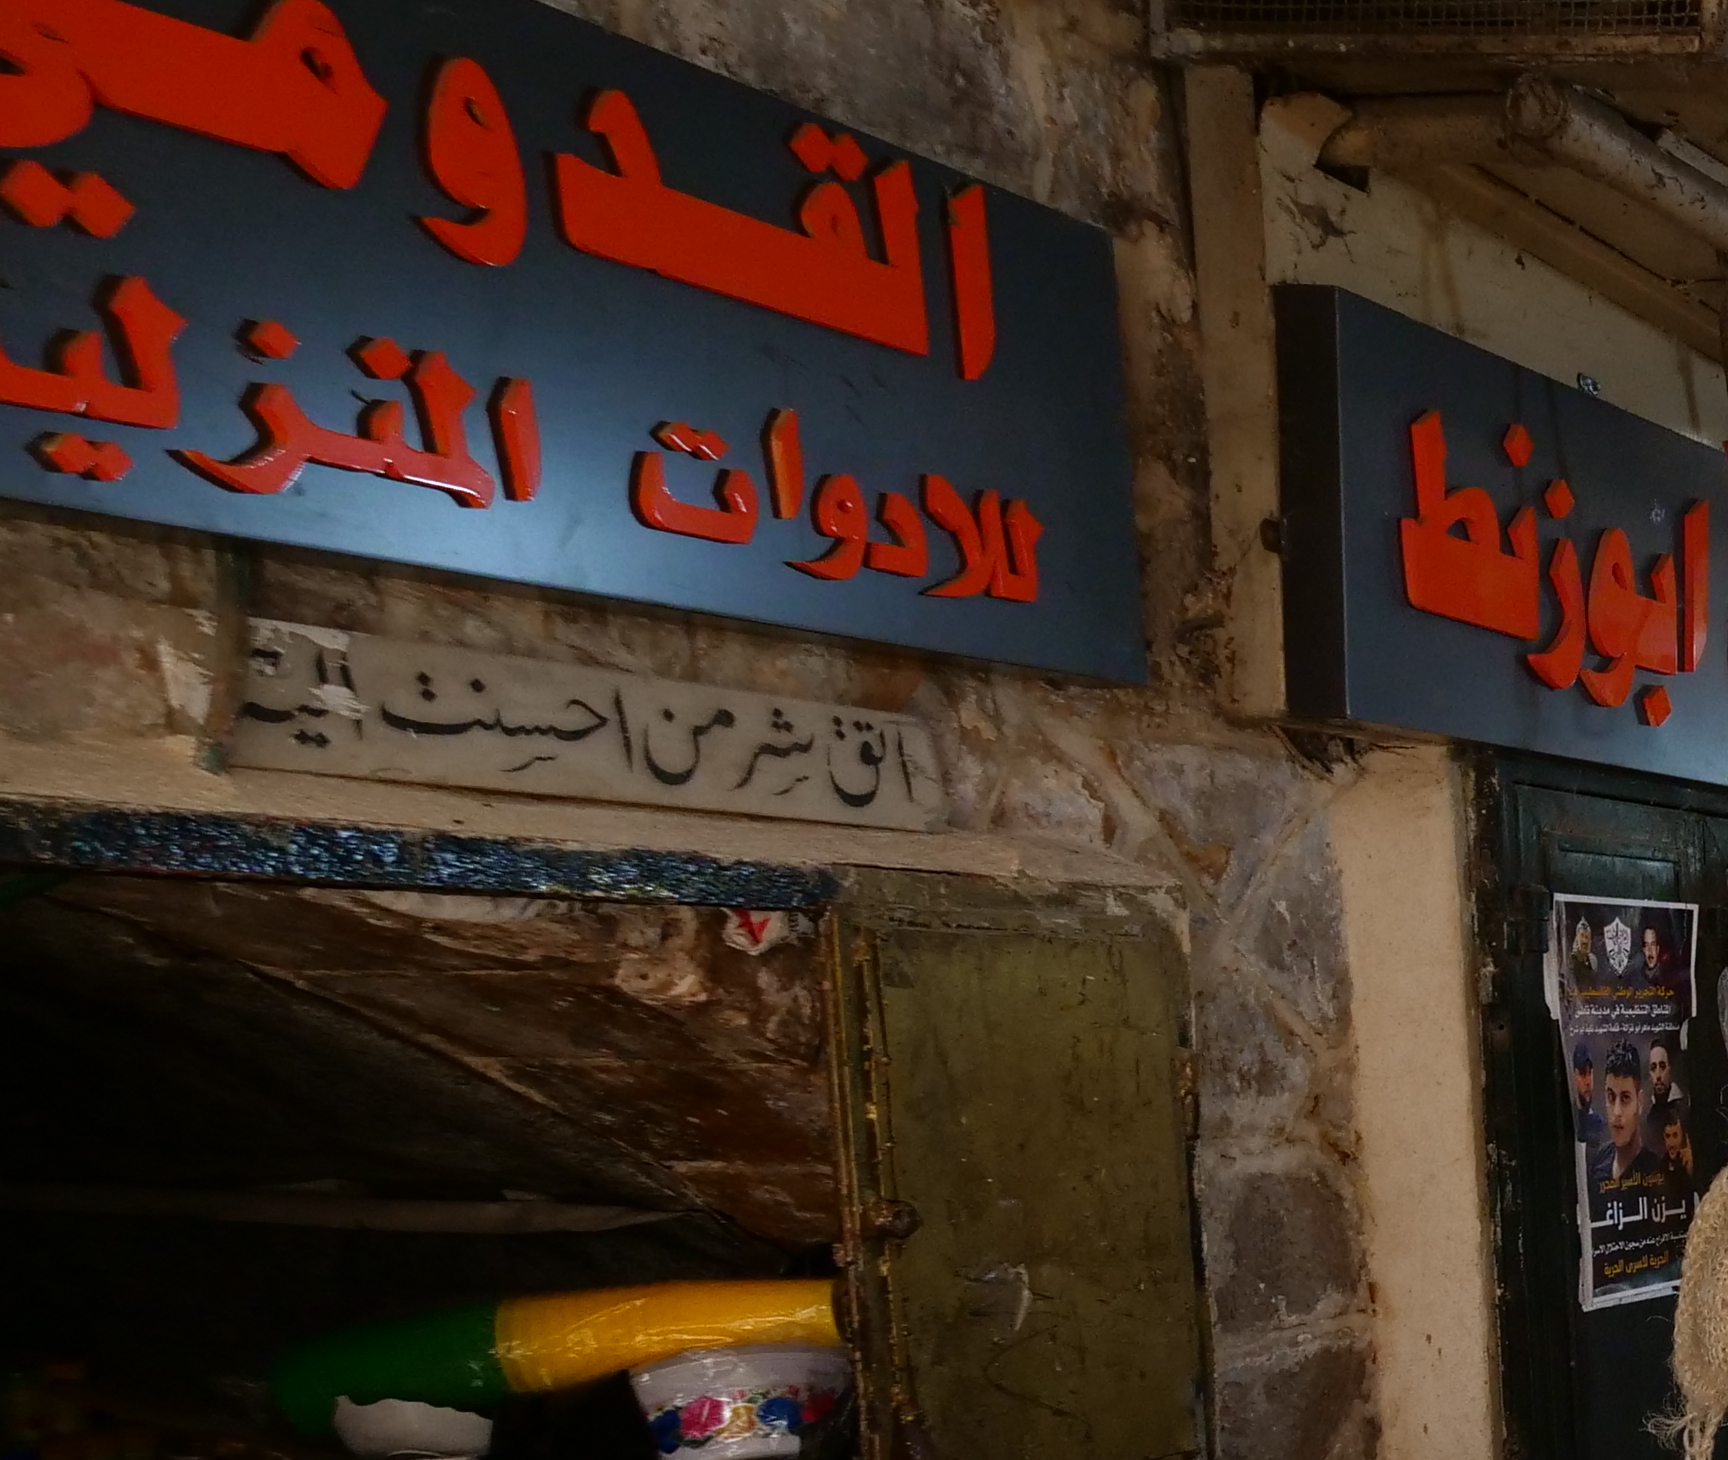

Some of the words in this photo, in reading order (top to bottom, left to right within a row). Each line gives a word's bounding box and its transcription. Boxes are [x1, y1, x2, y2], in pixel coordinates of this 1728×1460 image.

[0, 275, 542, 508] المنزلي
[630, 408, 1042, 602] للادوات
[644, 708, 735, 785] من
[1651, 1196, 1687, 1223] يزن
